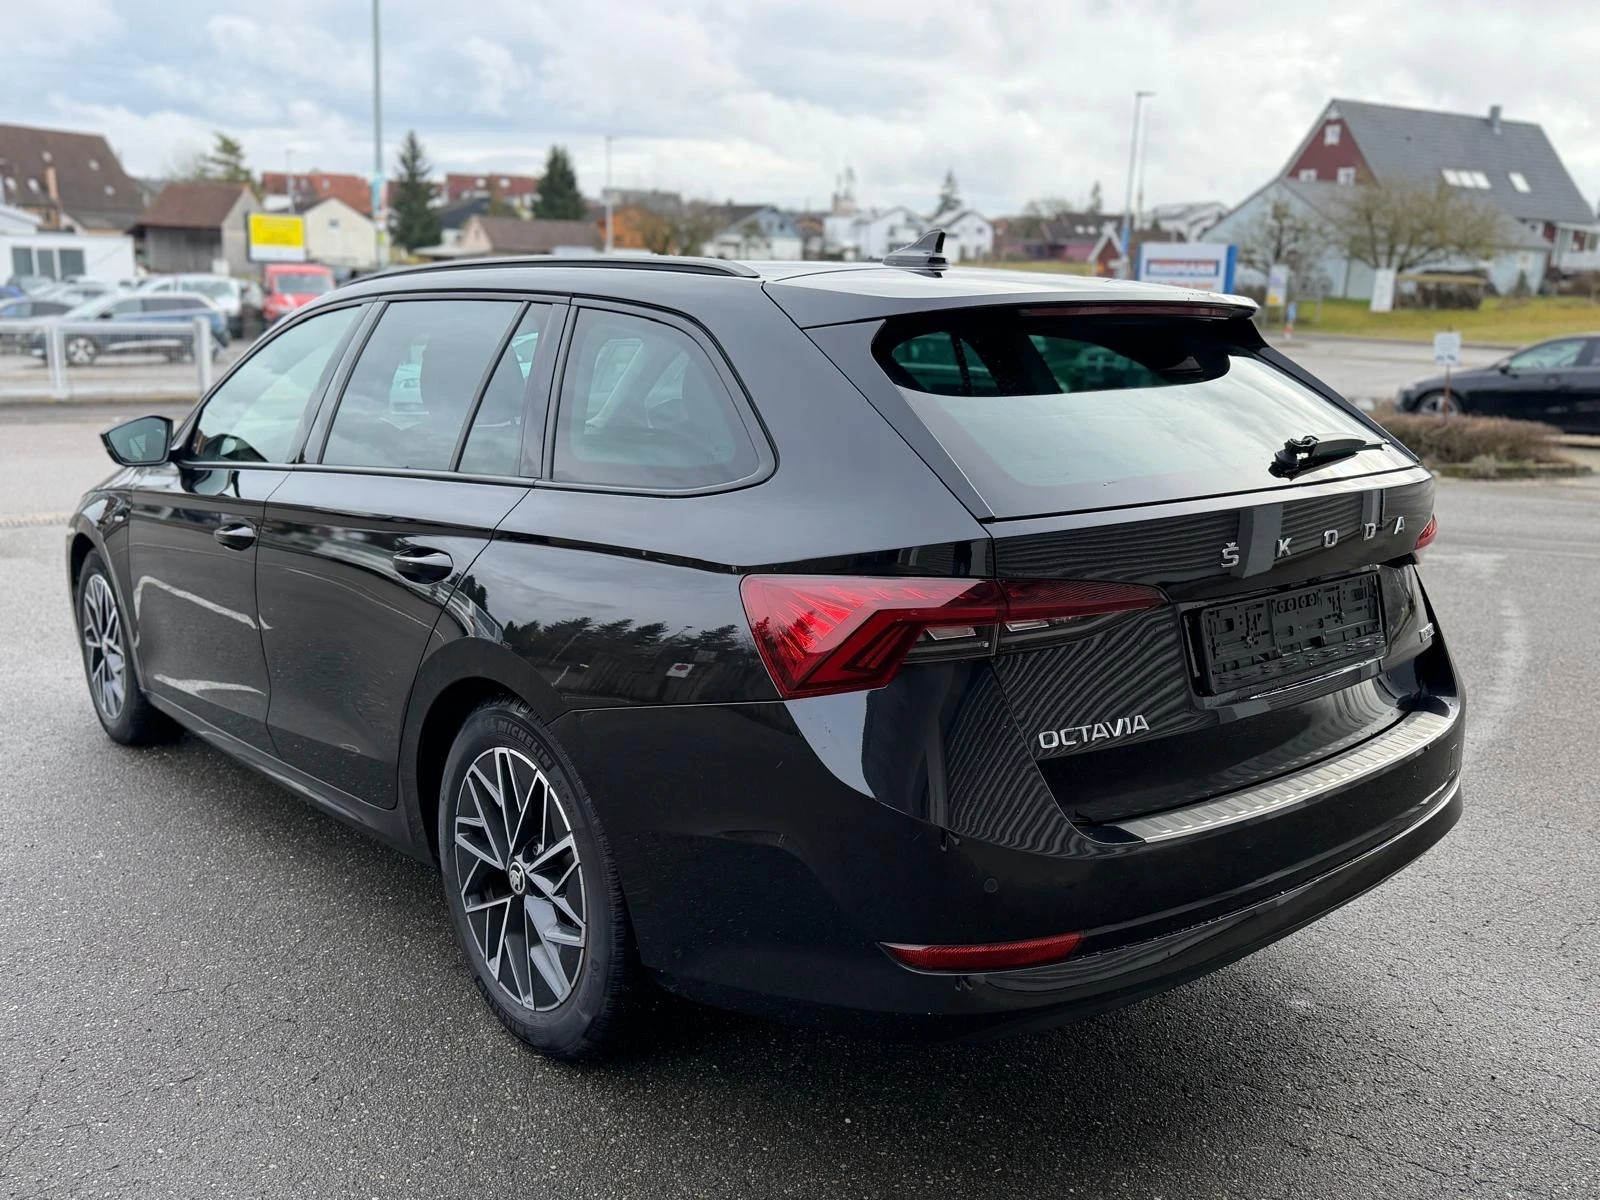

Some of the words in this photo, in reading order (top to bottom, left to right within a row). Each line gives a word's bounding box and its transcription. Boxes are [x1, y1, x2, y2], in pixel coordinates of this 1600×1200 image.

[1221, 516, 1405, 567] ŠKODA
[497, 720, 552, 768] MICHELIN
[1038, 714, 1150, 749] OCTAVIA
